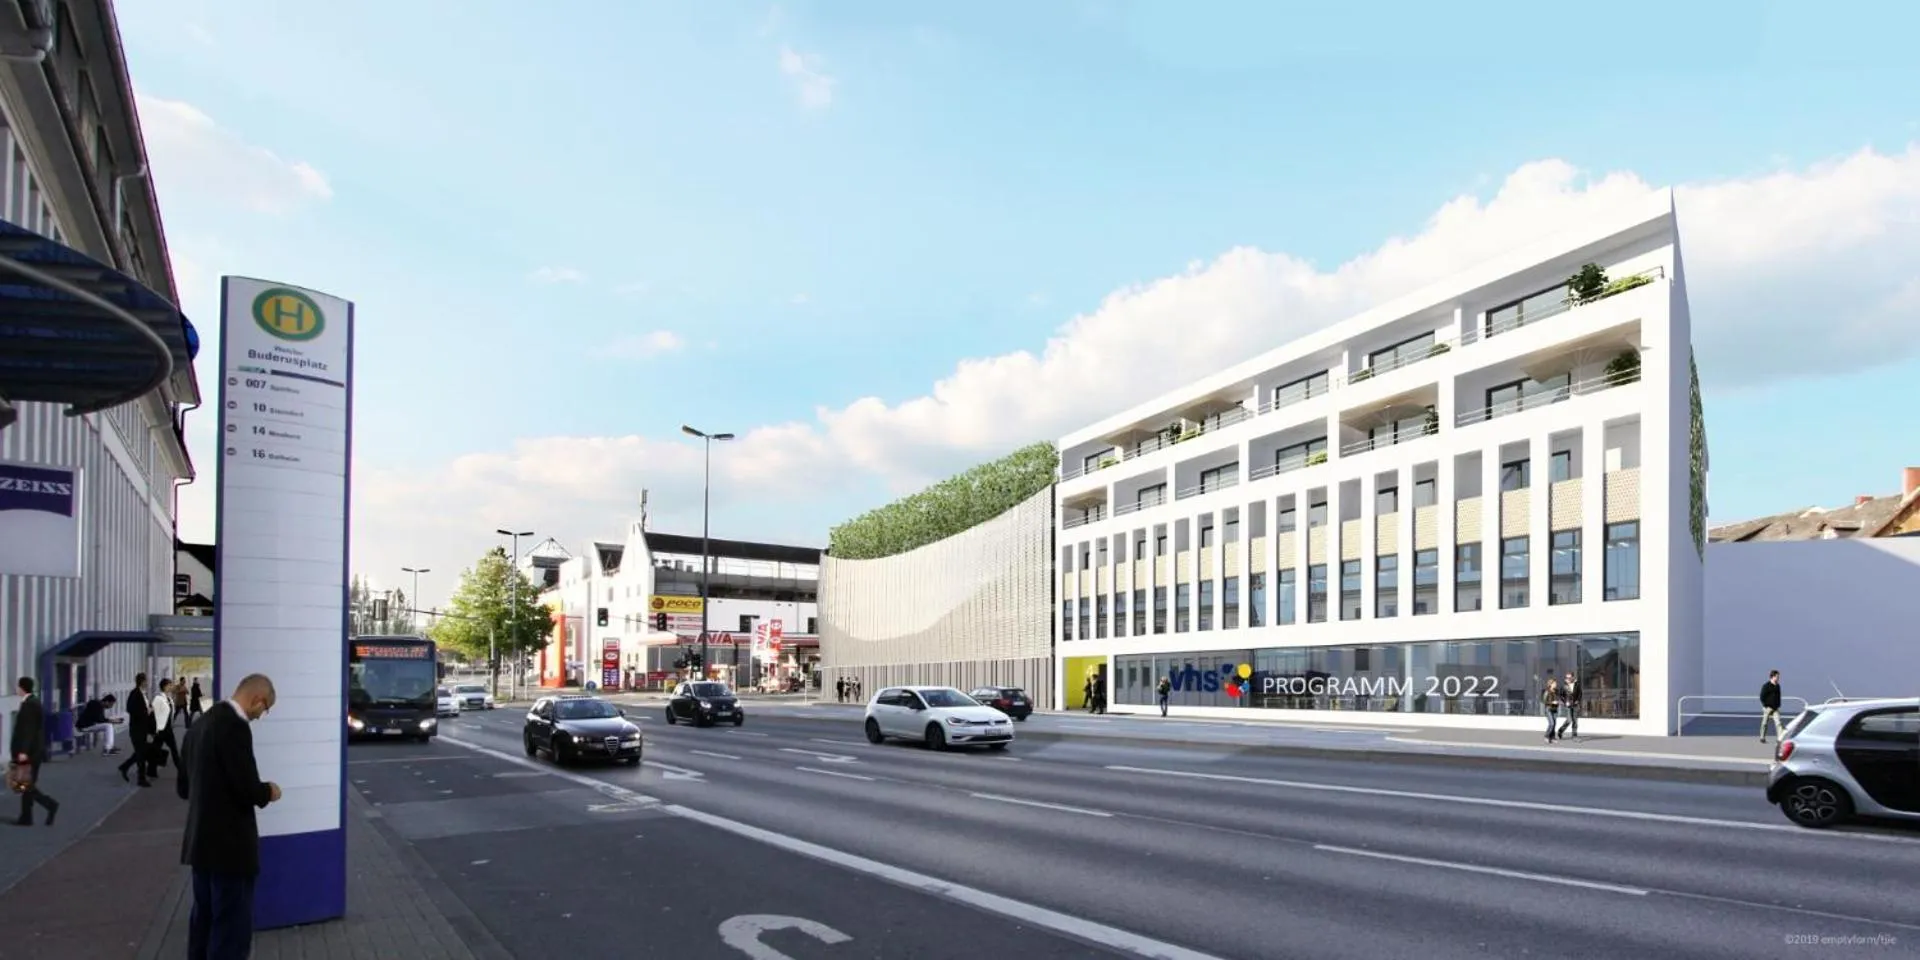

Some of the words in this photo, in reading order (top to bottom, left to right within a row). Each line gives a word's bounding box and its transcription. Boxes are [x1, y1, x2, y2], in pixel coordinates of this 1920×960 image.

[274, 298, 304, 331] H
[248, 348, 328, 371] Buderusplatz
[246, 378, 266, 389] 007
[253, 402, 266, 413] 10
[252, 425, 265, 435] 14
[252, 448, 265, 459] 16
[0, 476, 72, 496] ZEISS
[695, 632, 734, 645] AVIA
[1169, 662, 1220, 692] vhs
[1263, 676, 1414, 696] PROGRAMM
[1425, 675, 1501, 698] 2022
